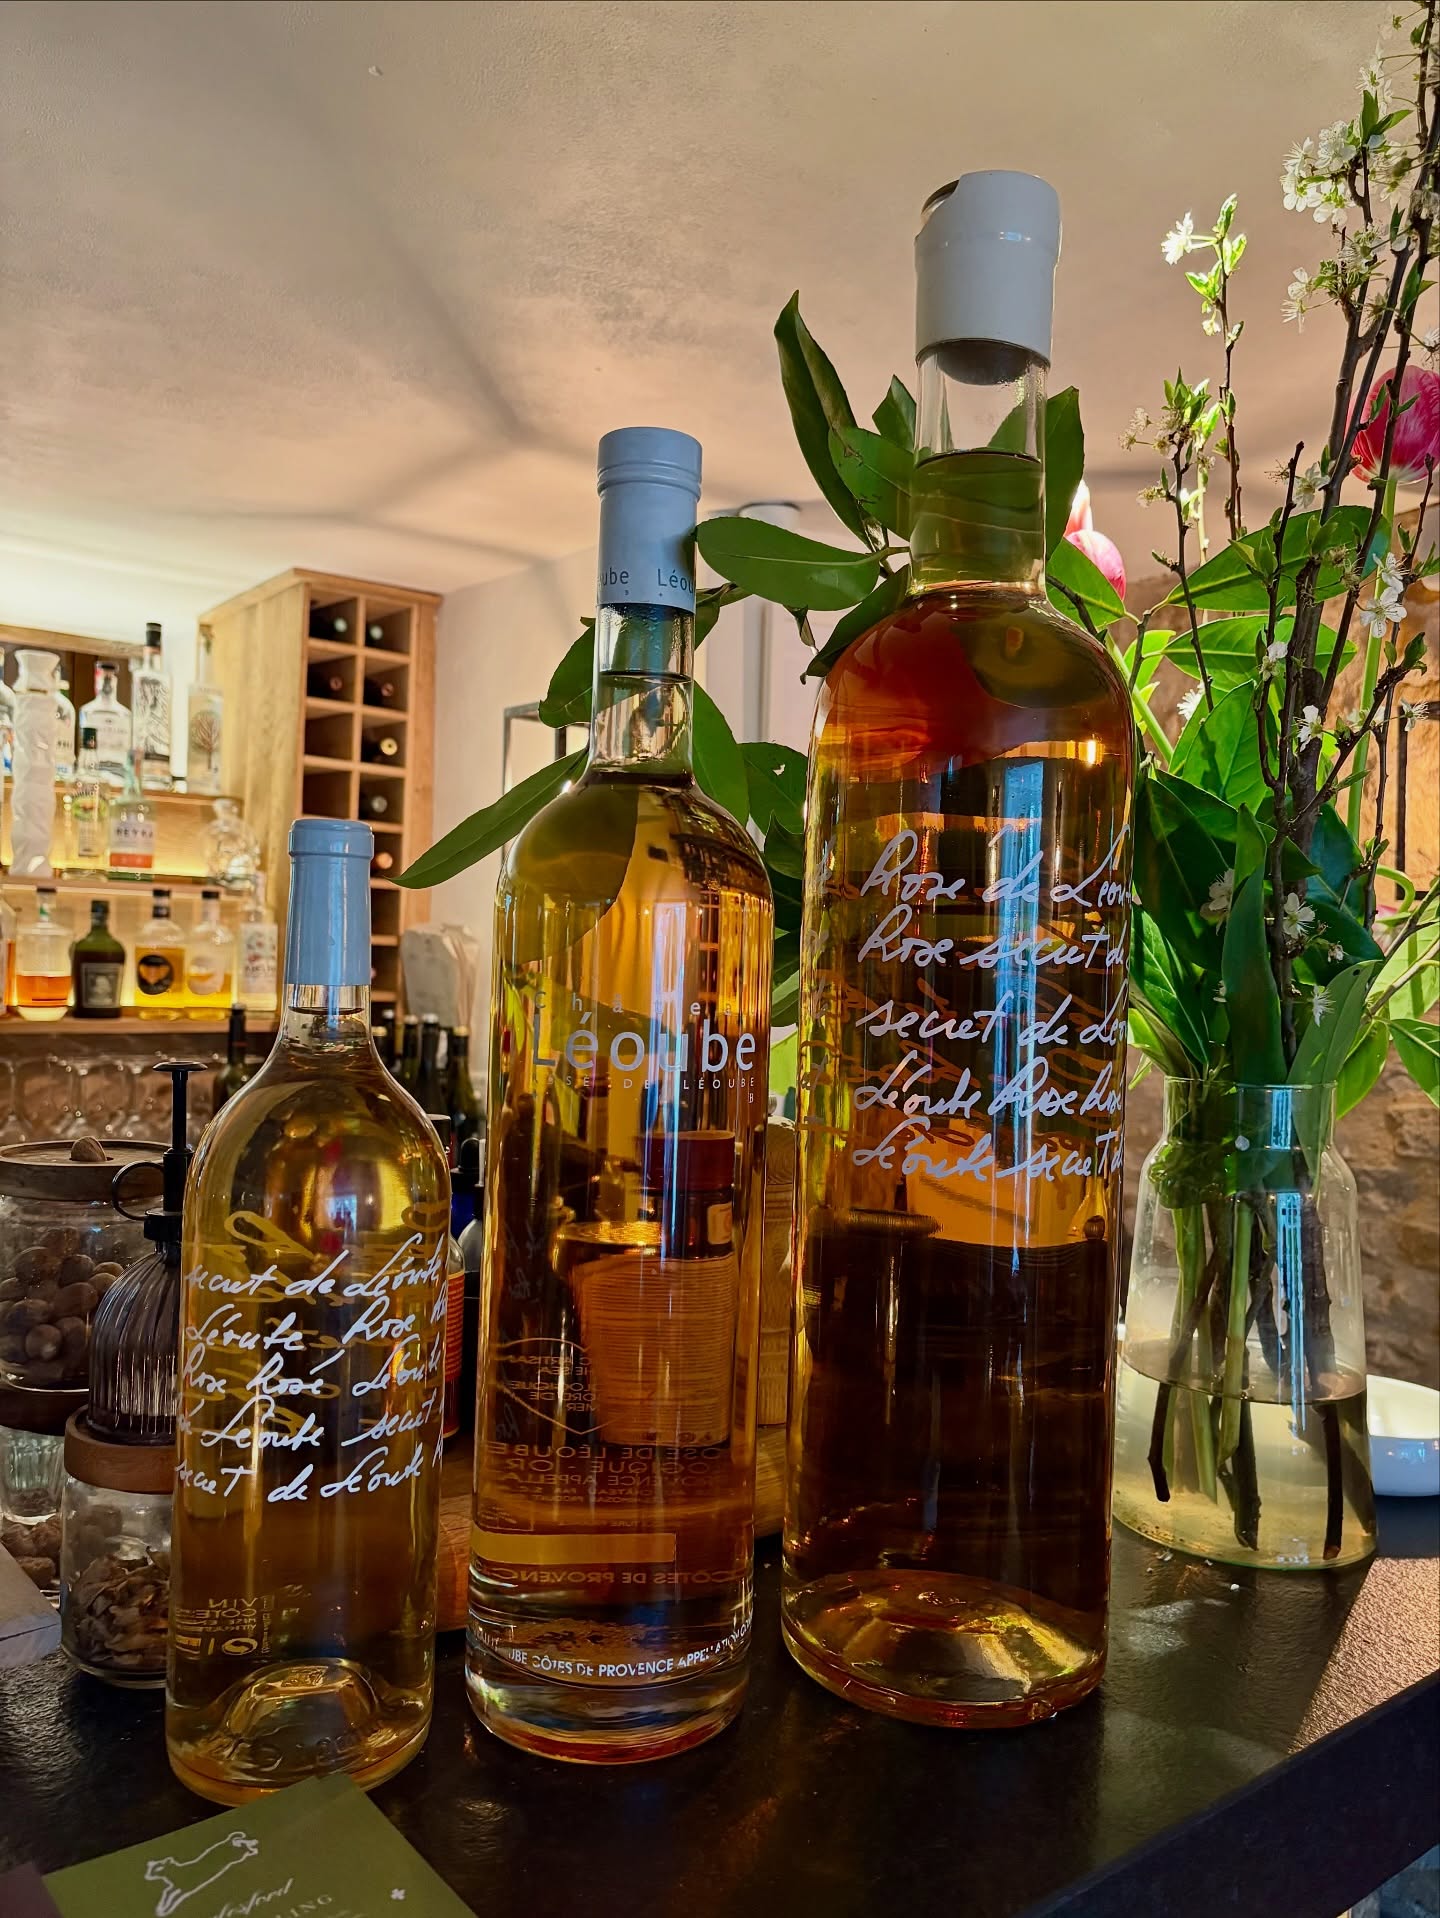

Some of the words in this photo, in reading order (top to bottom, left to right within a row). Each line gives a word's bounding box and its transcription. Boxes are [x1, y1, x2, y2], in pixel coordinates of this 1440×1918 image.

[981, 851, 1044, 903] de
[958, 925, 1110, 970] secret
[855, 990, 1015, 1044] secret
[1018, 993, 1073, 1047] de
[533, 1011, 756, 1073] Léoube
[683, 1076, 755, 1090] LÉOUBE
[285, 1250, 349, 1296] de
[268, 1463, 315, 1502] de
[598, 1657, 675, 1678] PROVENCE
